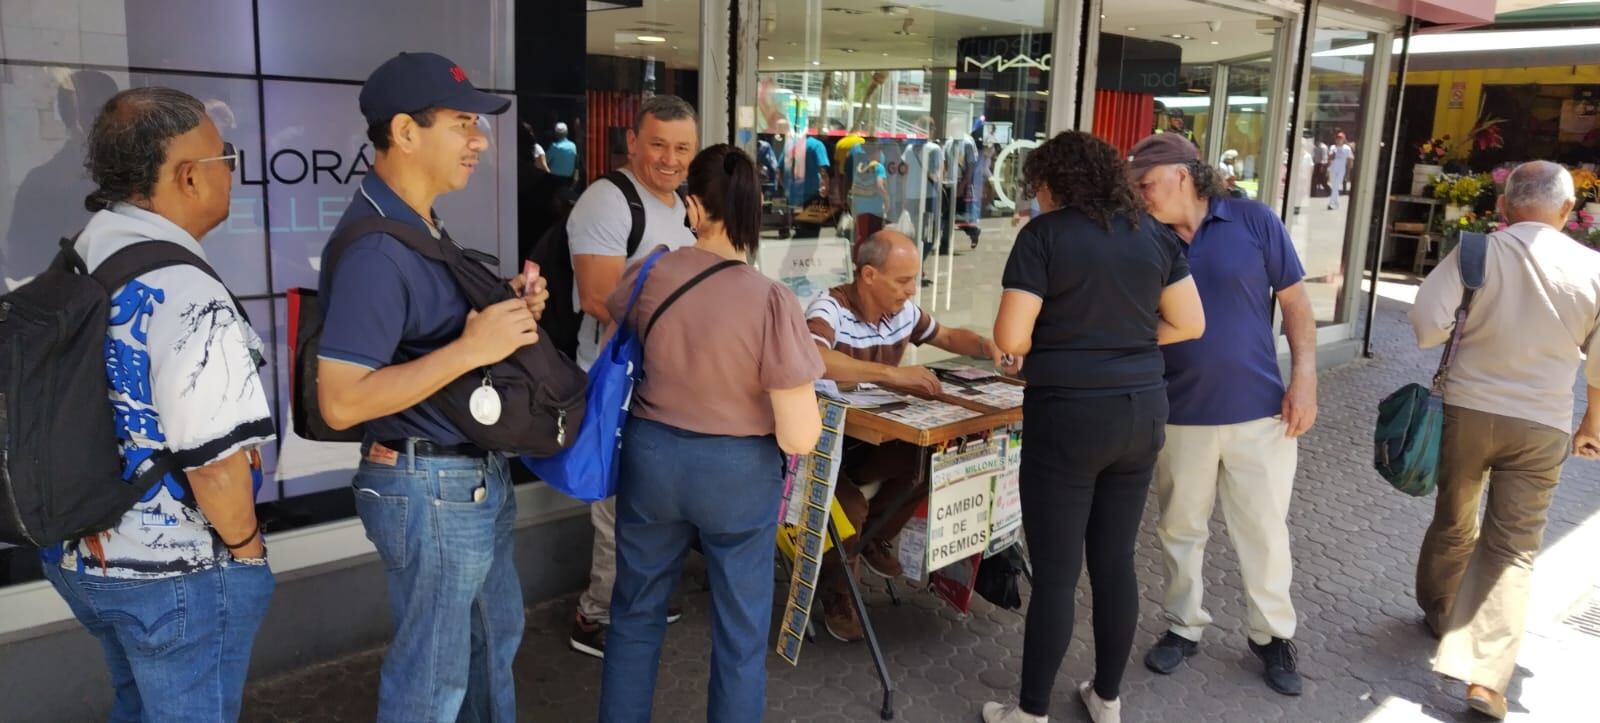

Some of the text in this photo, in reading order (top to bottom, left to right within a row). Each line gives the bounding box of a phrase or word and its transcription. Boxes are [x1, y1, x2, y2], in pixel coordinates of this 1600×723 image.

[228, 196, 351, 233] ELLE
[936, 493, 984, 521] CAMBIO
[952, 520, 968, 535] DE
[931, 529, 987, 562] PREMIOS
